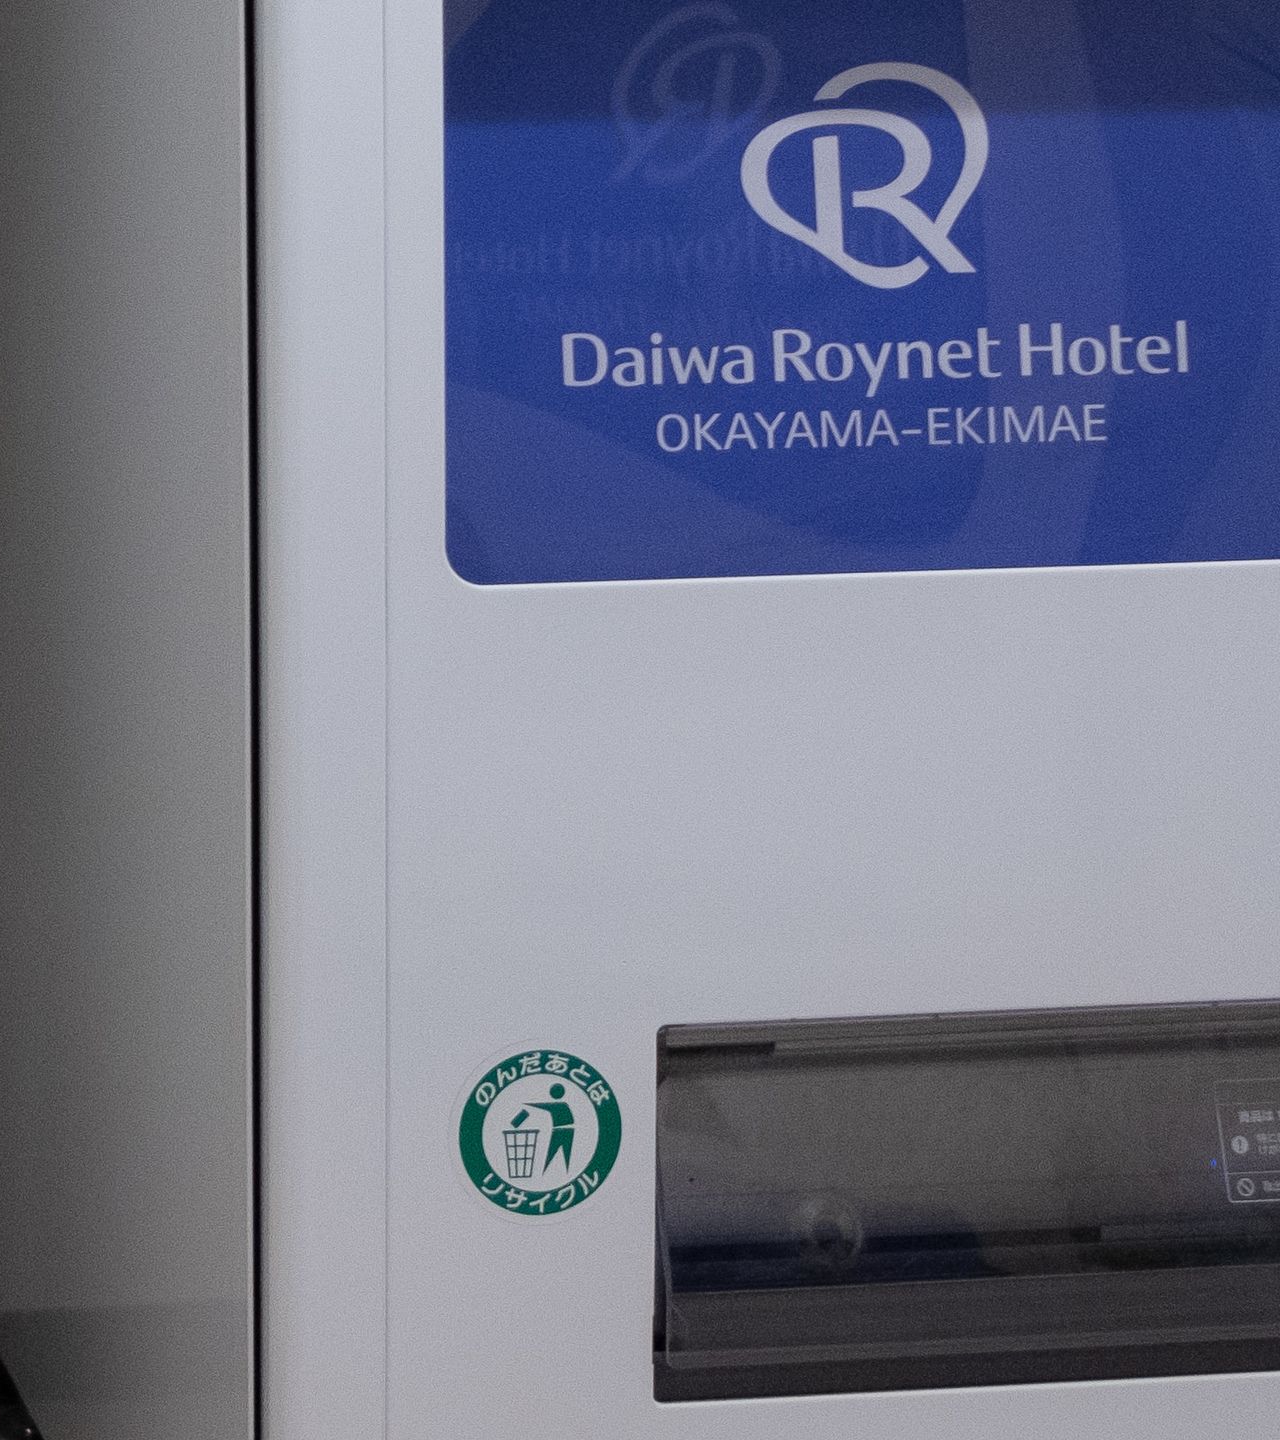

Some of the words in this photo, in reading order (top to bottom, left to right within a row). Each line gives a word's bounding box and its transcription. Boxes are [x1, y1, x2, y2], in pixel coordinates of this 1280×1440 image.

[561, 331, 756, 389] Daiwa
[772, 326, 1002, 398] Roynet
[1019, 319, 1190, 377] Hotel
[656, 404, 1108, 453] OKAYAMA-EKIMAE
[475, 1051, 611, 1107] のんだあとは
[481, 1170, 600, 1214] リサイクル
